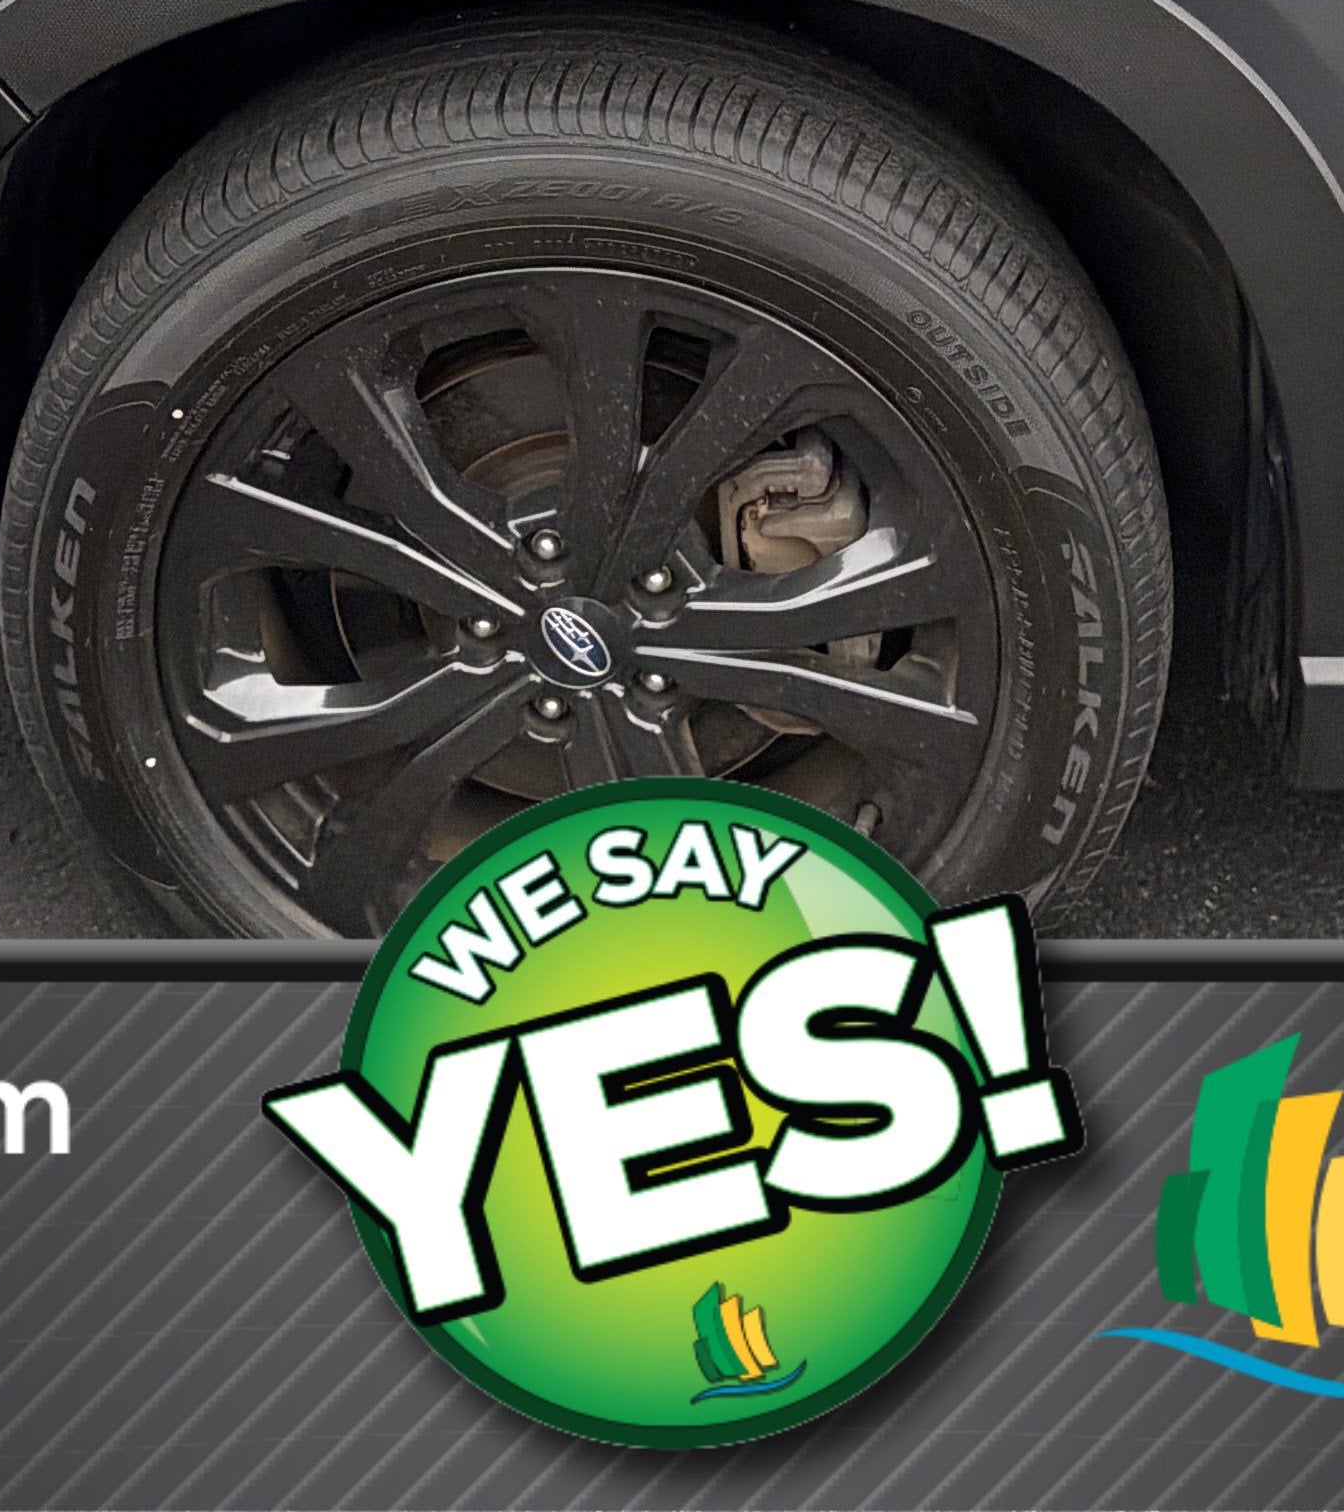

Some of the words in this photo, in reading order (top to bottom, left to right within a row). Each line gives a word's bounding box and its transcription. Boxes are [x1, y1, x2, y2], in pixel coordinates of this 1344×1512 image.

[907, 309, 1031, 438] OUTSIDE
[50, 476, 105, 782] FALKEN
[1040, 529, 1105, 846] FALKEN
